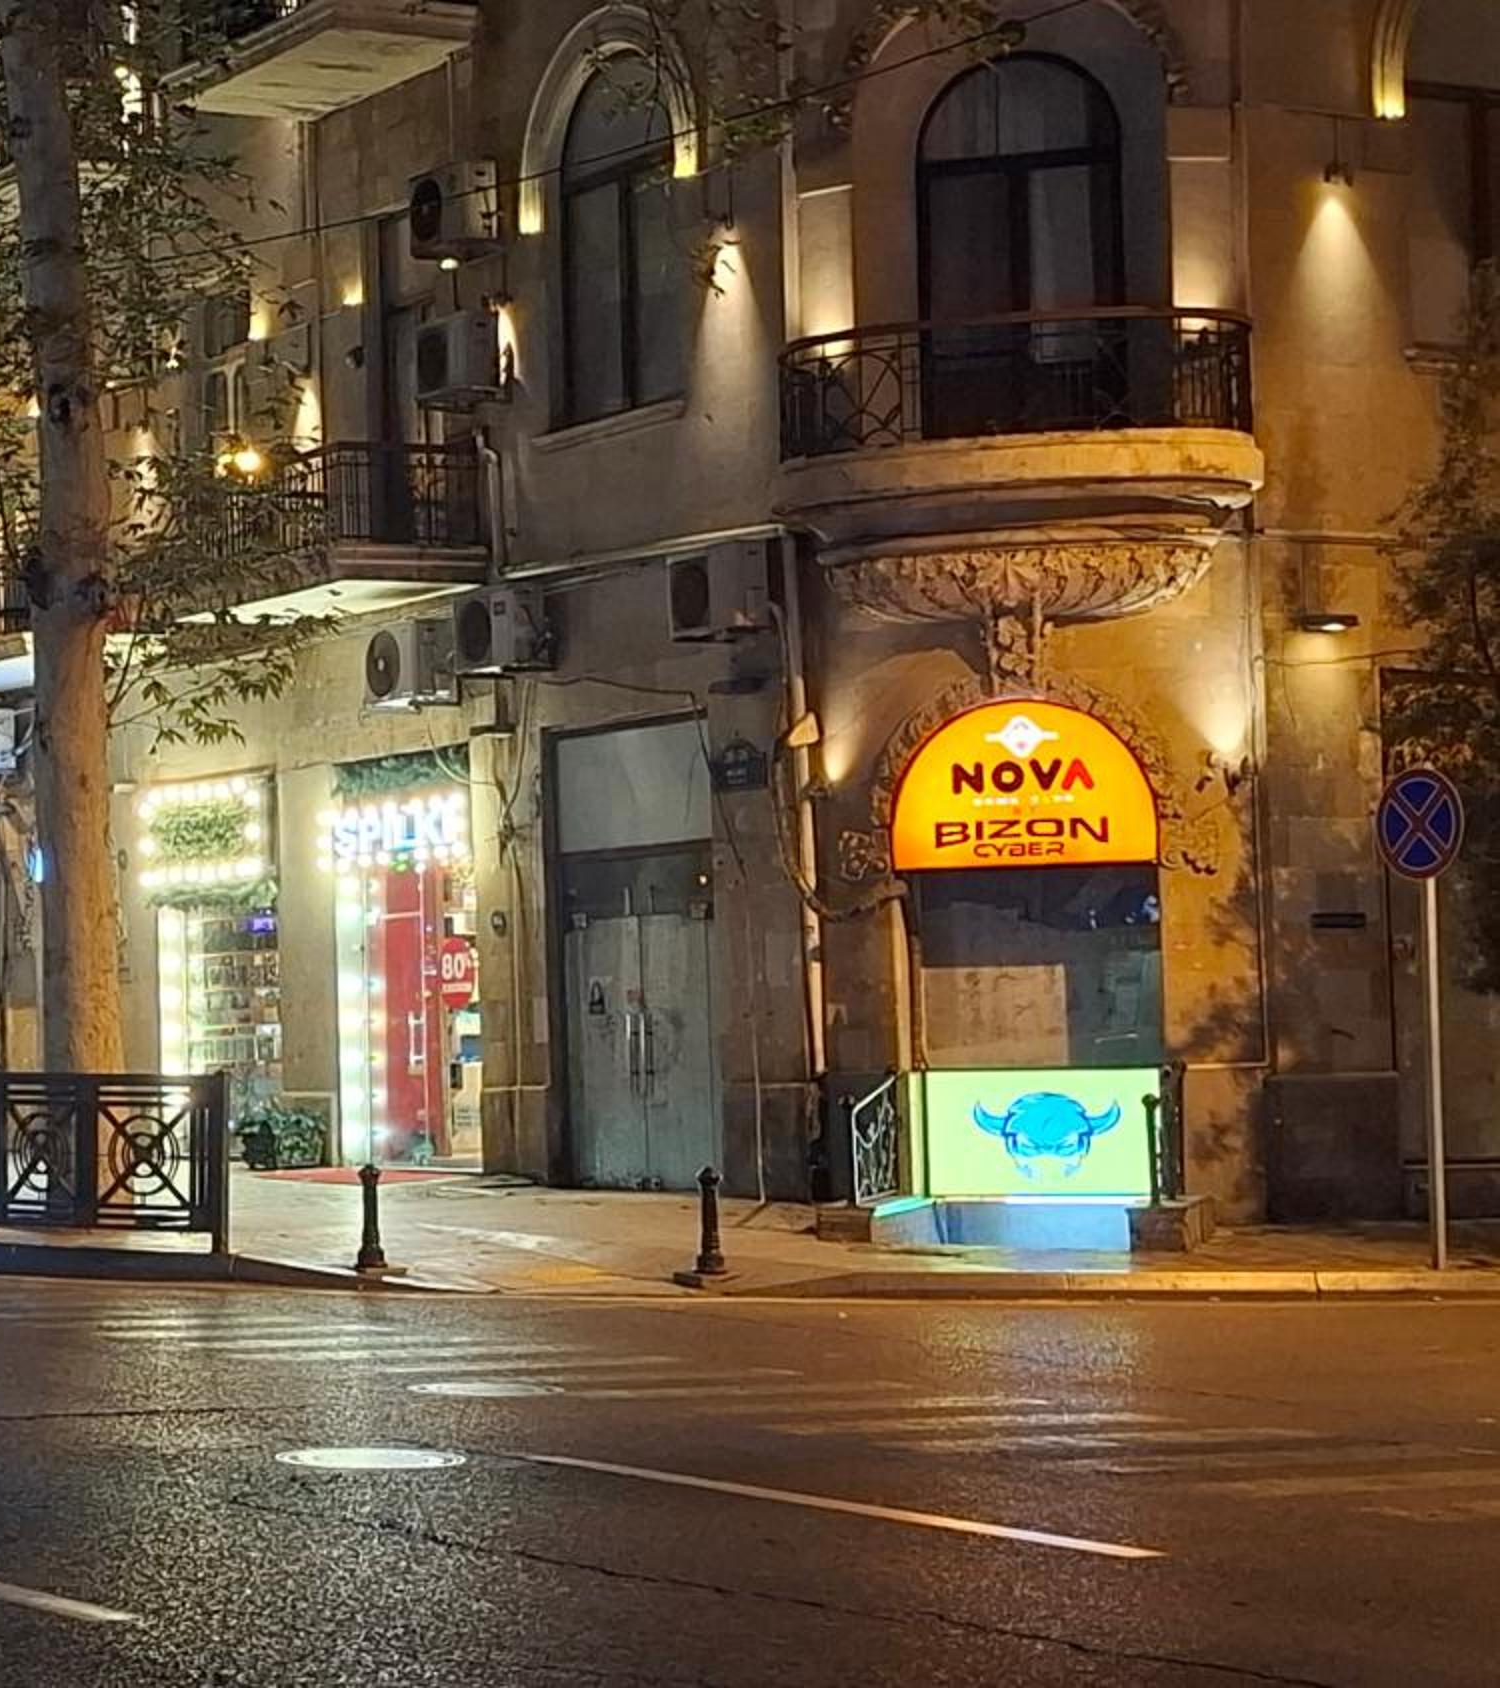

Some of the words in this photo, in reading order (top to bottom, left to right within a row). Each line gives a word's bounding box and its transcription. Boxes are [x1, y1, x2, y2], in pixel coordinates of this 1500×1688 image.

[952, 758, 1094, 794] NOVA
[935, 816, 1109, 848] BIZON
[973, 841, 1064, 858] CYBER
